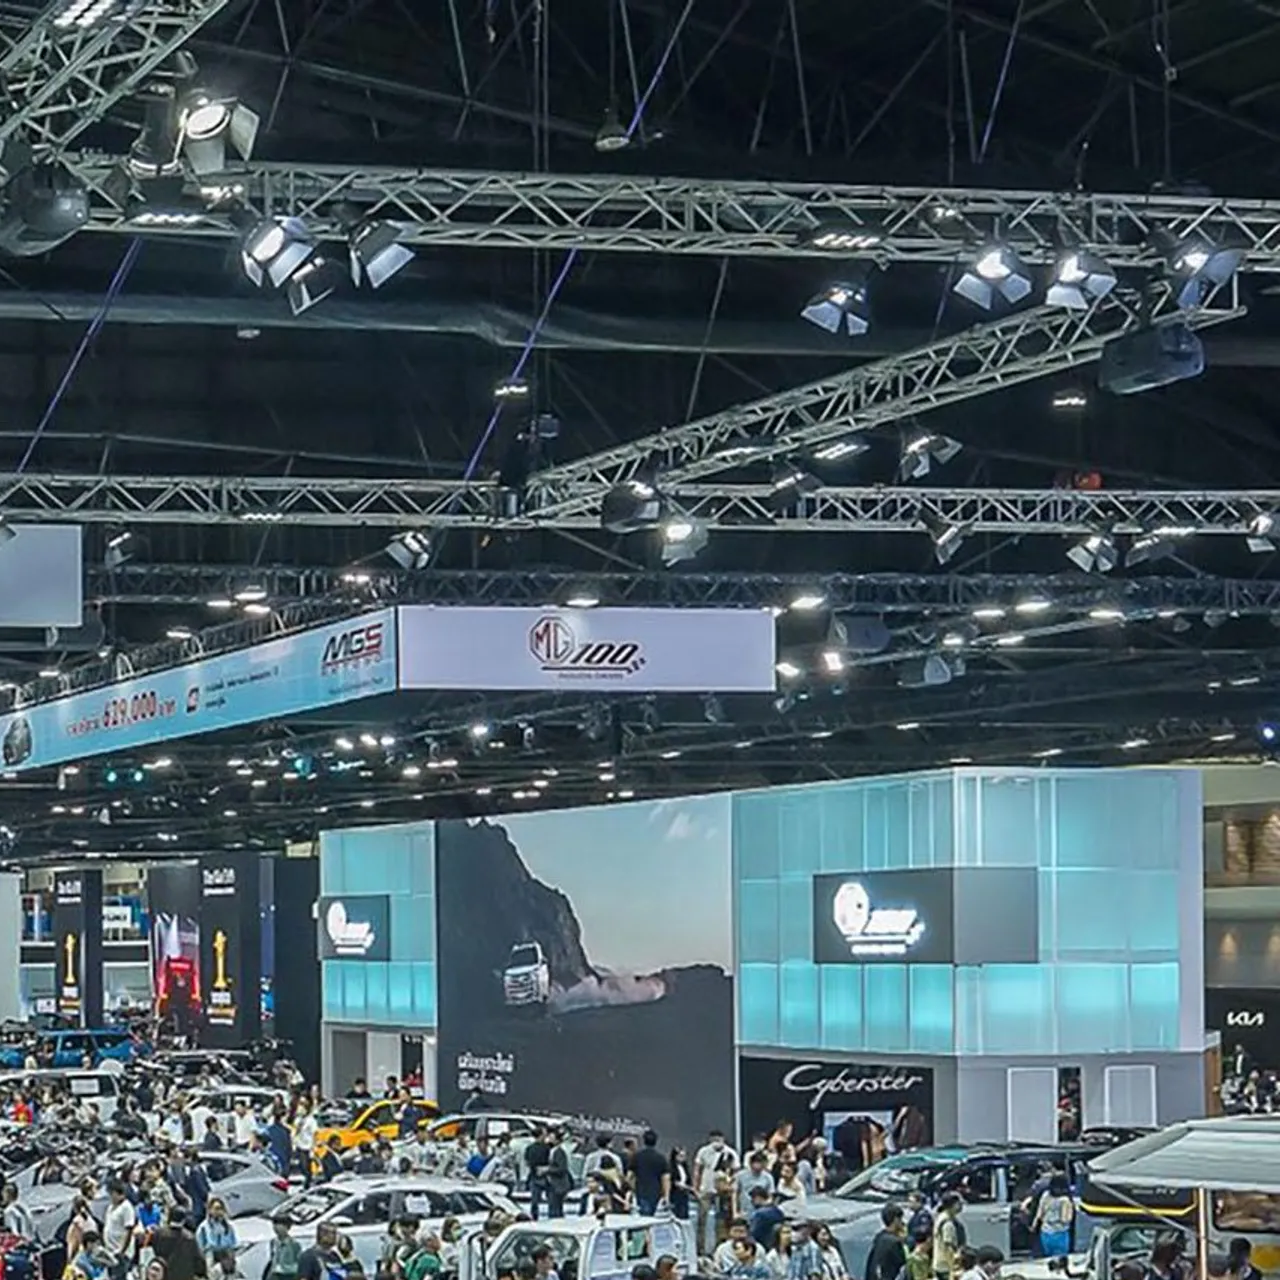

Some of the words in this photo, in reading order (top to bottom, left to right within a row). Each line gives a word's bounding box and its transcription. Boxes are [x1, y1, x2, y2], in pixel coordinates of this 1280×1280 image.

[569, 642, 640, 665] 100
[1226, 1010, 1265, 1026] KIA
[783, 1063, 923, 1110] Cyberster
